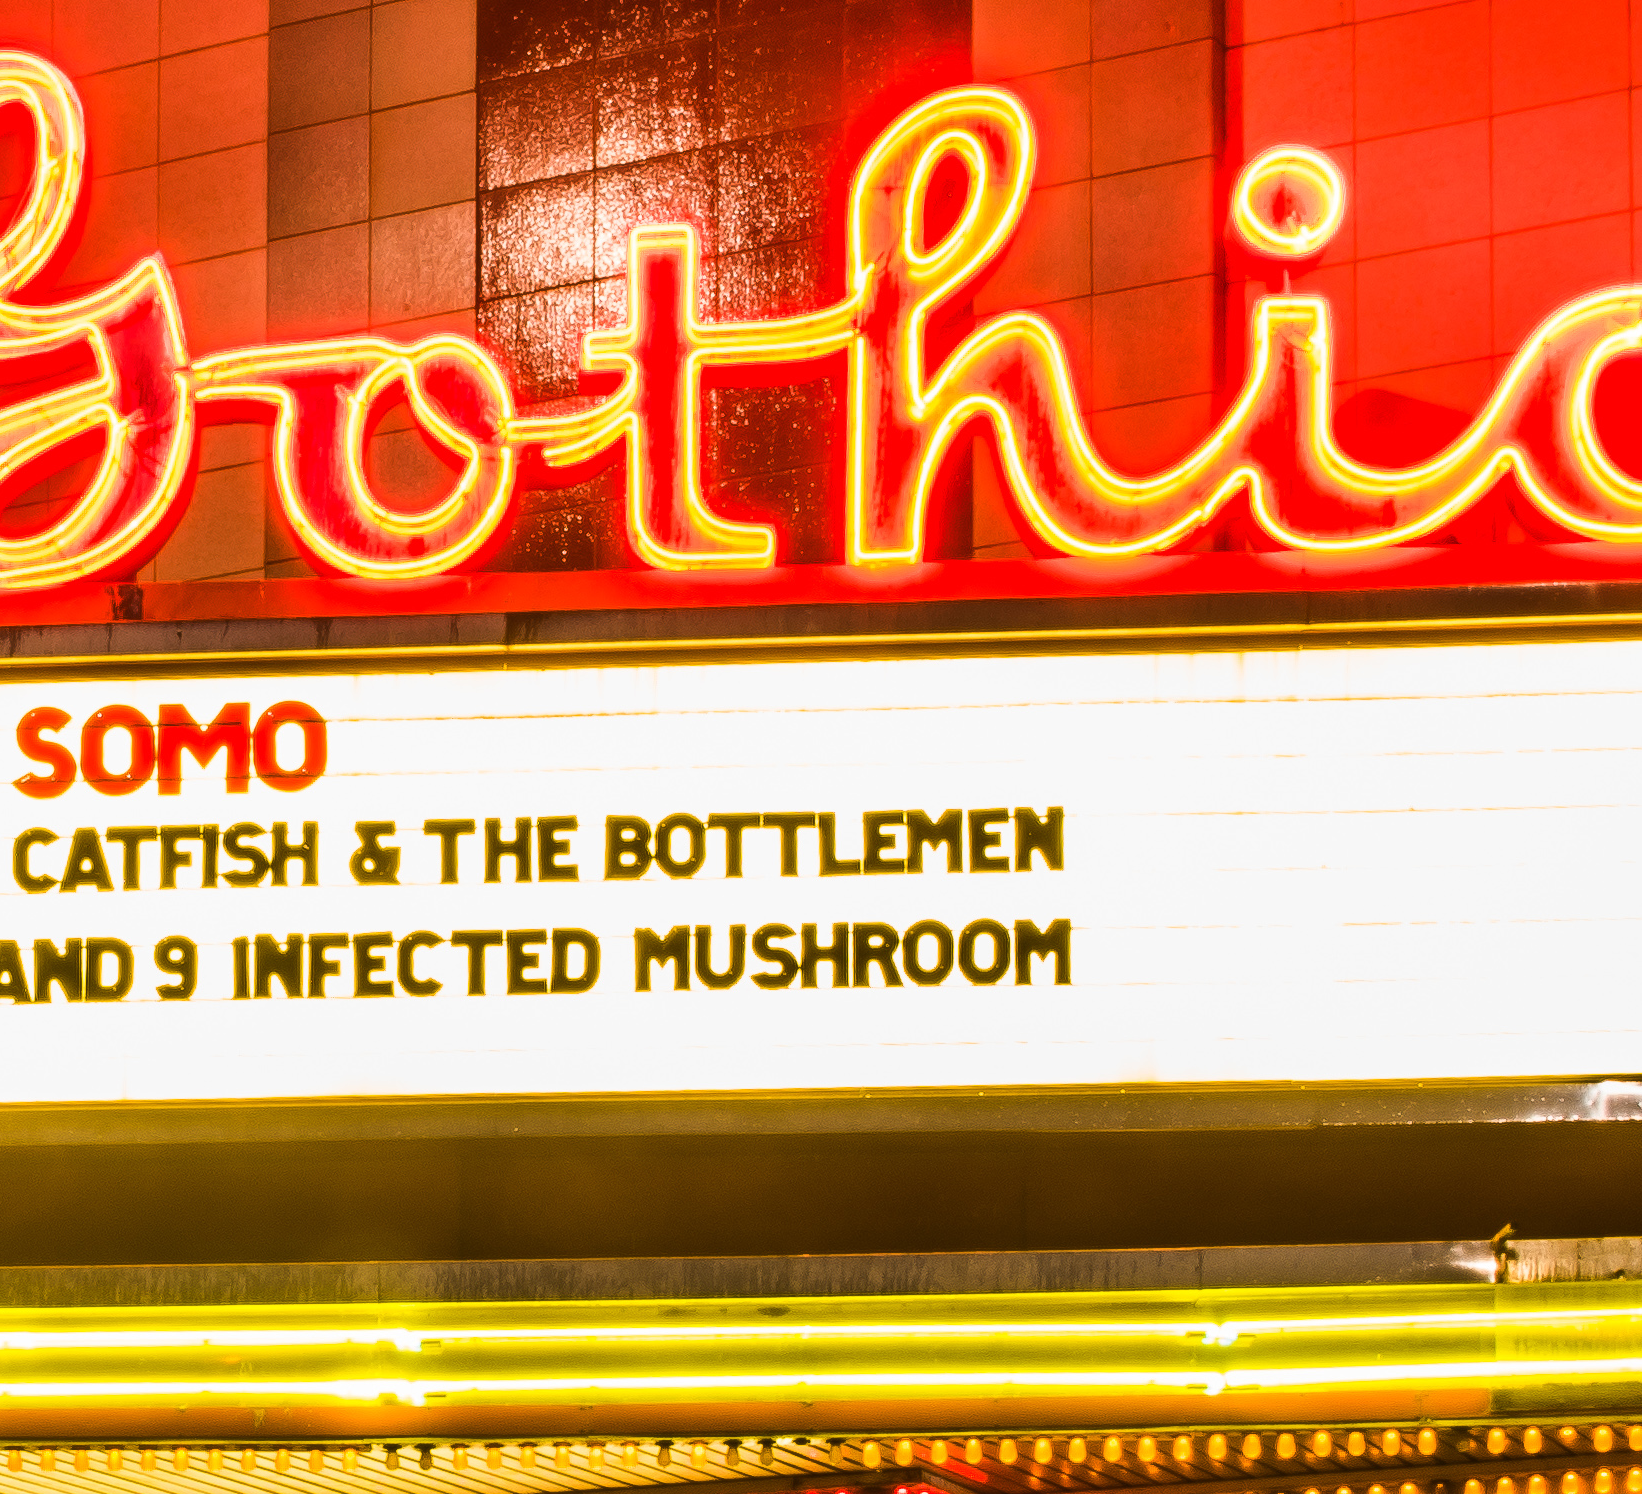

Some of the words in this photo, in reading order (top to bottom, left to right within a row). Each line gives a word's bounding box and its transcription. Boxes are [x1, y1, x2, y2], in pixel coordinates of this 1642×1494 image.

[12, 700, 328, 799] SOMO
[13, 820, 319, 895] CATFISH
[349, 820, 402, 886] &
[423, 814, 580, 885] THE
[603, 805, 1066, 882] BOTTLEMEN
[153, 934, 198, 1001] 9
[231, 926, 601, 1001] INFECTED
[634, 917, 1073, 992] MUSHROOM
